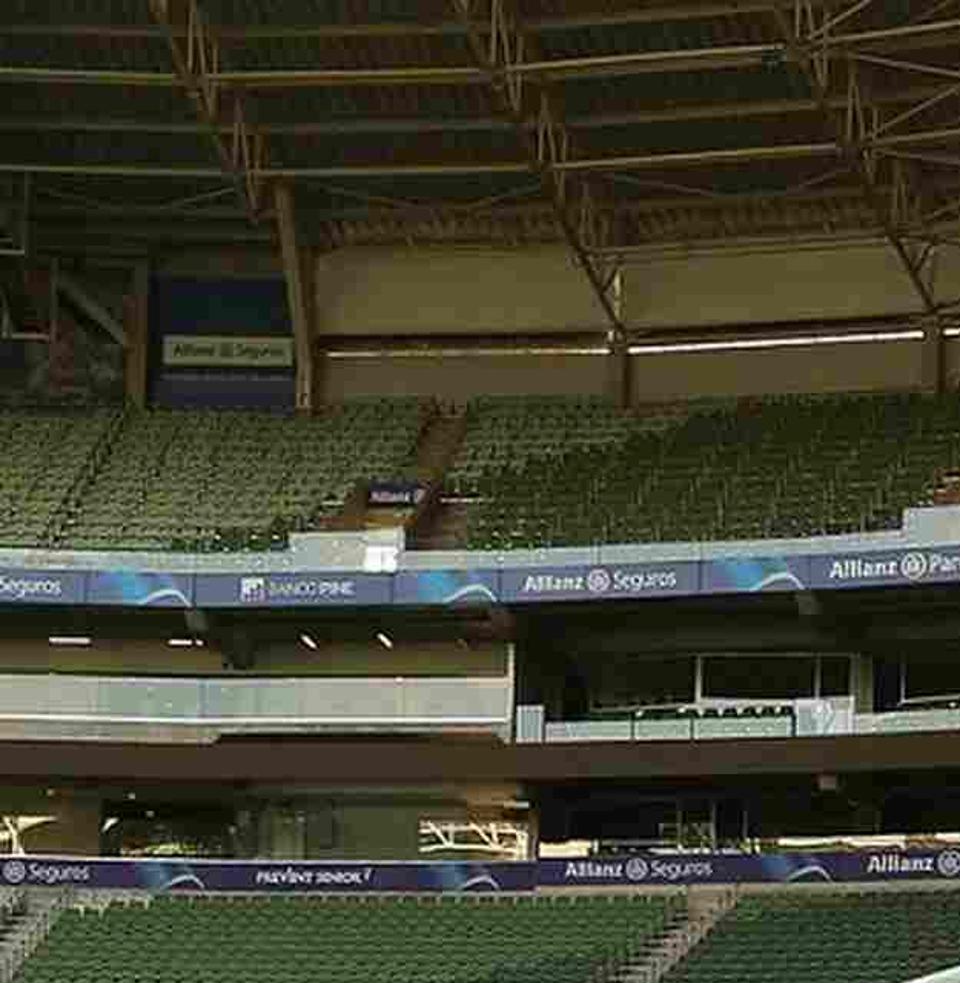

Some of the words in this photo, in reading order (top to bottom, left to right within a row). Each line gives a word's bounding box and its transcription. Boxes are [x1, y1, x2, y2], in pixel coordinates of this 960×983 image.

[829, 557, 898, 578] Allianz
[525, 574, 585, 592] Allianz
[613, 570, 677, 591] Seguros
[28, 862, 90, 884] Seguros
[565, 861, 623, 878] Allianz
[650, 859, 713, 880] Seguros
[867, 854, 934, 873] Allianz
